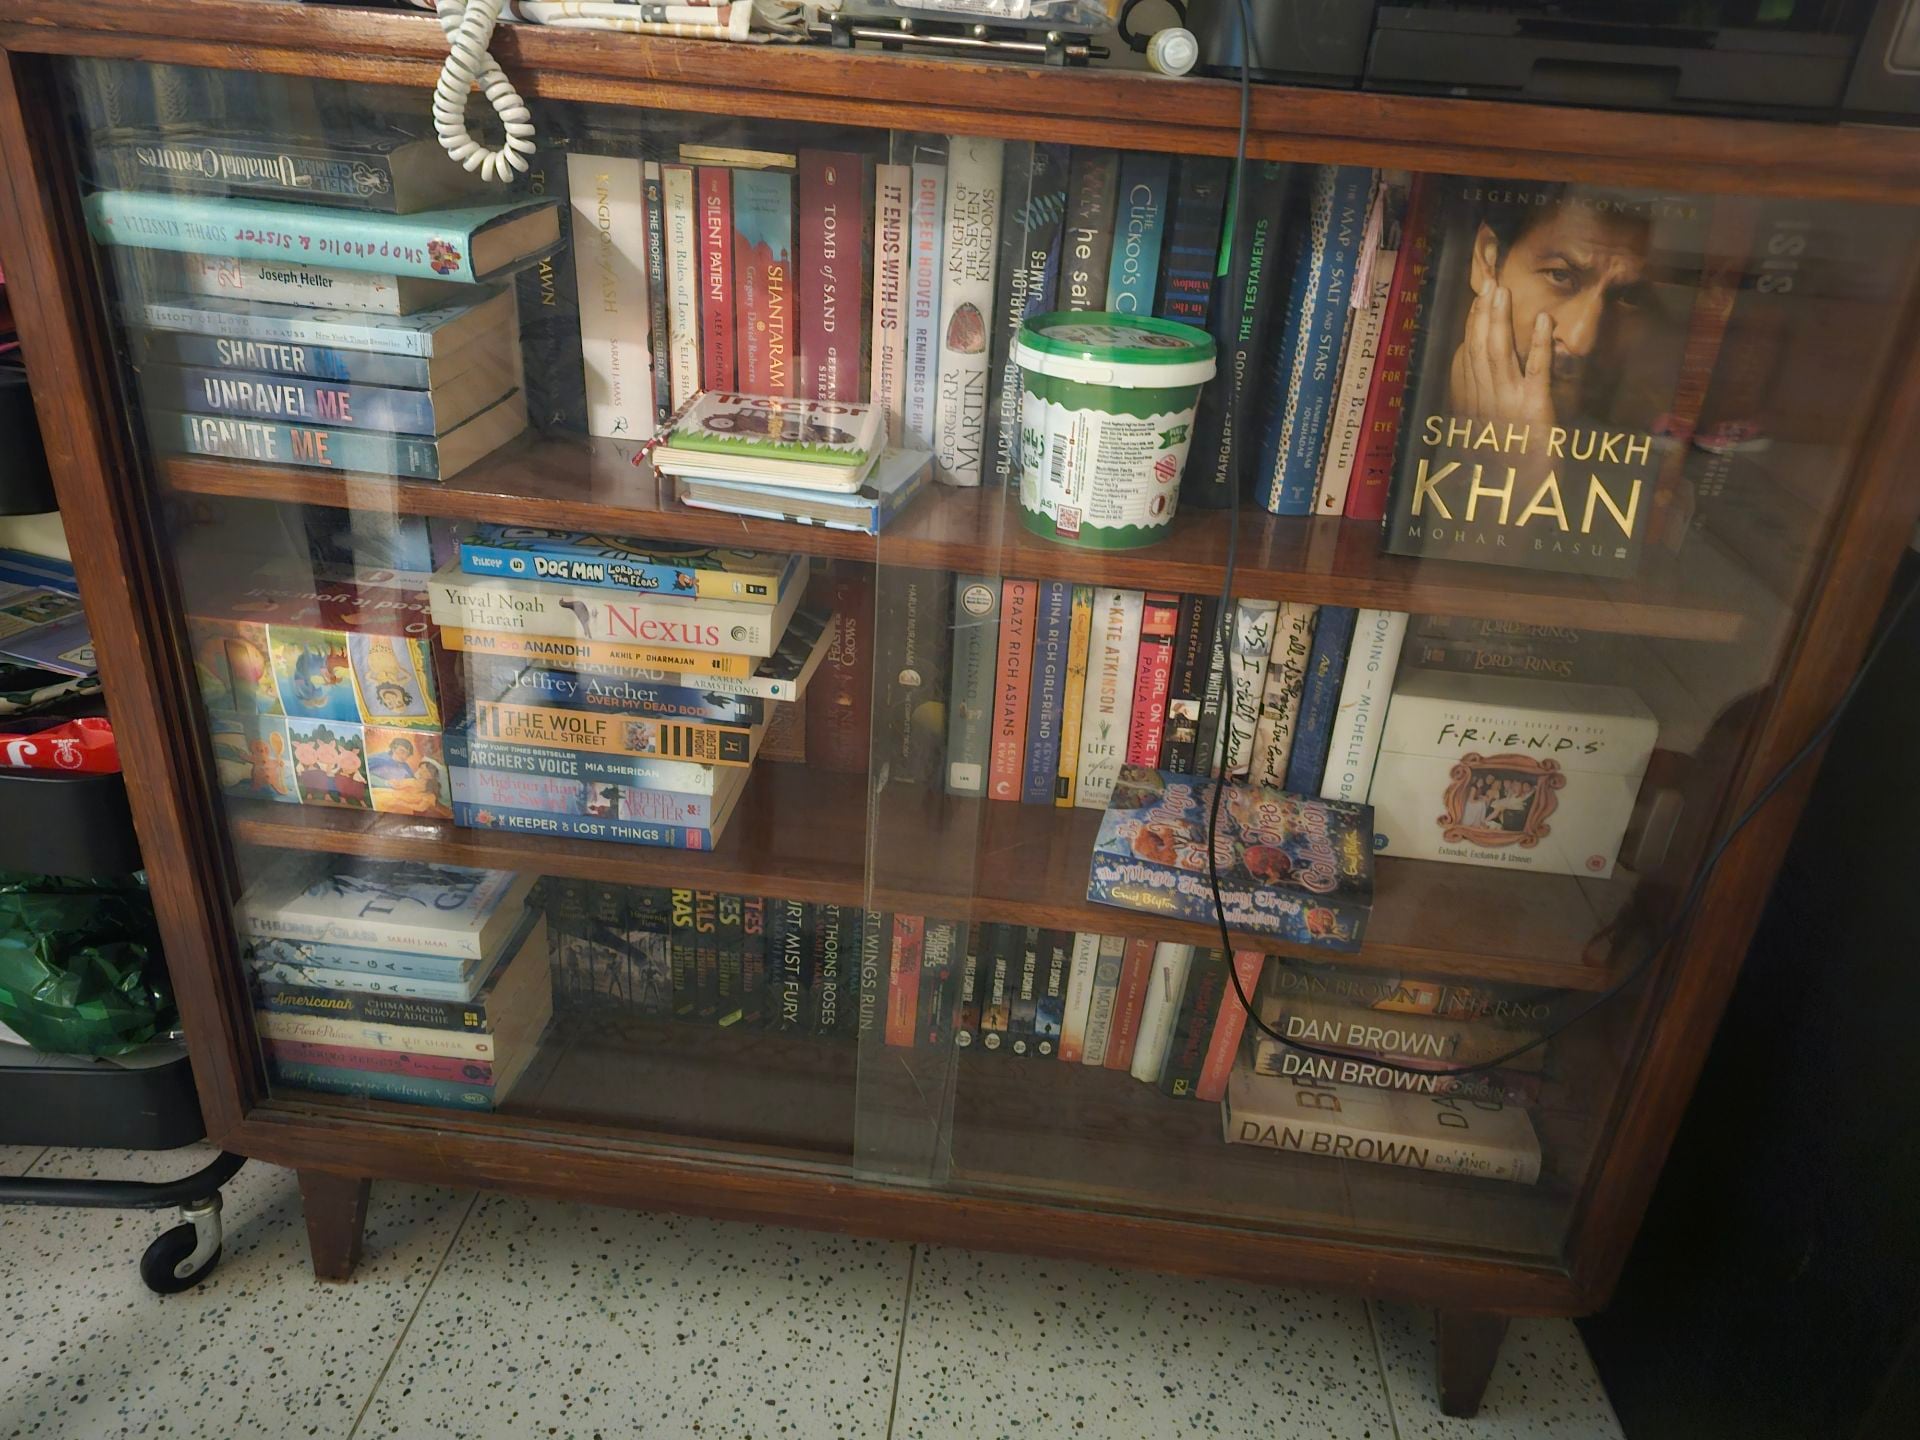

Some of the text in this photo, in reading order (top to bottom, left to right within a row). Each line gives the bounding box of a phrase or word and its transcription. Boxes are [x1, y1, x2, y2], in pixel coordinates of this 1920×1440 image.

[137, 147, 296, 186] Unnatural Creatures
[1462, 187, 1549, 207] LEGEND
[186, 222, 226, 241] SOPHIE
[235, 229, 422, 265] Shopaholic & Sister
[648, 208, 662, 281] THE PROPHET
[950, 182, 967, 274] KNIGHT OF
[965, 191, 981, 279] THE SEVEN
[976, 188, 995, 282] KINGDOMS
[1074, 227, 1098, 260] he
[1122, 183, 1152, 285] CUCKOO'S
[674, 193, 690, 330] The Forty Rules of Love
[707, 196, 723, 302] SILENT PATIENT
[823, 204, 837, 332] TOMB SAND
[881, 206, 902, 305] ENDS WITH
[915, 178, 937, 319] COLLEEN HOOVER
[259, 267, 297, 285] Joseph
[300, 273, 334, 288] Heller
[1009, 250, 1047, 328] MARLON JAMES
[1238, 219, 1269, 342] THE TESTAMENTS
[1312, 206, 1356, 381] MAP OF SALT AND STARS
[713, 311, 722, 337] ALEX
[767, 265, 785, 389] SHANTARAM
[1362, 281, 1390, 358] Married
[216, 339, 307, 374] SHATTER
[1388, 344, 1406, 357] EYE
[911, 328, 928, 434] REMINDERS OF HIM
[1358, 366, 1368, 380] to
[1381, 371, 1401, 383] FOR
[204, 377, 352, 422] UNRAVEL ME
[1389, 396, 1402, 408] AN
[939, 399, 958, 471] GEORGE
[957, 369, 984, 474] MARTIN
[1338, 397, 1365, 468] Bedouin
[1373, 421, 1393, 433] EYE
[1421, 413, 1652, 467] SHAH RUKH
[191, 418, 332, 465] IGNITE ME
[996, 427, 1014, 475] BLACK
[1410, 458, 1643, 540] KHAN
[1408, 525, 1604, 558] MOHAR BASU
[472, 555, 632, 582] PILKEY DOG MAN LORD
[445, 588, 545, 614] Yuval Noah
[469, 608, 525, 629] Harari
[604, 603, 720, 647] Nexus
[840, 617, 857, 667] CROWS
[905, 617, 918, 666] MURAKAMI
[1293, 614, 1306, 634] To
[463, 633, 695, 667] RAM ANANDHI AKHIL DHARMAJAN
[1002, 584, 1025, 737] CRAZY RICH ASIANS
[1039, 582, 1064, 739] CHINA RICH GIRLFRIEND
[1099, 607, 1125, 716] KATE ATKINSON
[1474, 649, 1575, 678] LORD RINGS
[508, 669, 659, 703] Jeffrey Archer
[694, 680, 760, 697] ARMSTRONG
[1136, 656, 1153, 703] PAULA
[1146, 636, 1172, 752] THE GIRL ON THE
[1203, 669, 1223, 717] WHITE LIE
[504, 710, 608, 736] THE WOLF
[586, 694, 677, 714] OVER MY DEAD
[505, 726, 608, 748] OF WALL STREET
[694, 729, 718, 760] JORDAN BELFORT
[1087, 743, 1117, 757] LIFE
[1346, 694, 1372, 768] MICHELLE
[470, 751, 660, 779] ARCHER'S VOICE MIA SHERIDAN
[471, 742, 577, 760] NEW TIMES BESTSELLER
[996, 742, 1018, 775] KEVIN KWAN
[1033, 742, 1042, 773] KWAN
[1084, 775, 1112, 789] LIFE
[508, 815, 660, 841] KEEPER LOST THINGS
[823, 922, 839, 978] THORNS
[862, 935, 882, 989] WINGS
[964, 954, 977, 976] JAMES
[994, 957, 1007, 979] JAMES
[1023, 950, 1037, 972] JAMES
[1051, 946, 1064, 969] JAMES
[1077, 938, 1093, 977] PAMUK
[783, 932, 801, 1024] MIST FURY
[1279, 971, 1420, 1005] DAN BROWN
[270, 993, 354, 1011] Americanah
[364, 1007, 449, 1025] NGOZI ADICHIE
[367, 1000, 445, 1015] CHIMAMANDA
[821, 981, 837, 1025] ROSES
[860, 991, 877, 1030] RUIN
[1286, 1016, 1447, 1058] DAN BROWN
[1281, 1054, 1336, 1081] DAN
[1340, 1062, 1438, 1094] BROWN
[1454, 1080, 1506, 1097] ORIGIN
[1238, 1120, 1430, 1171] DAN BROWN
